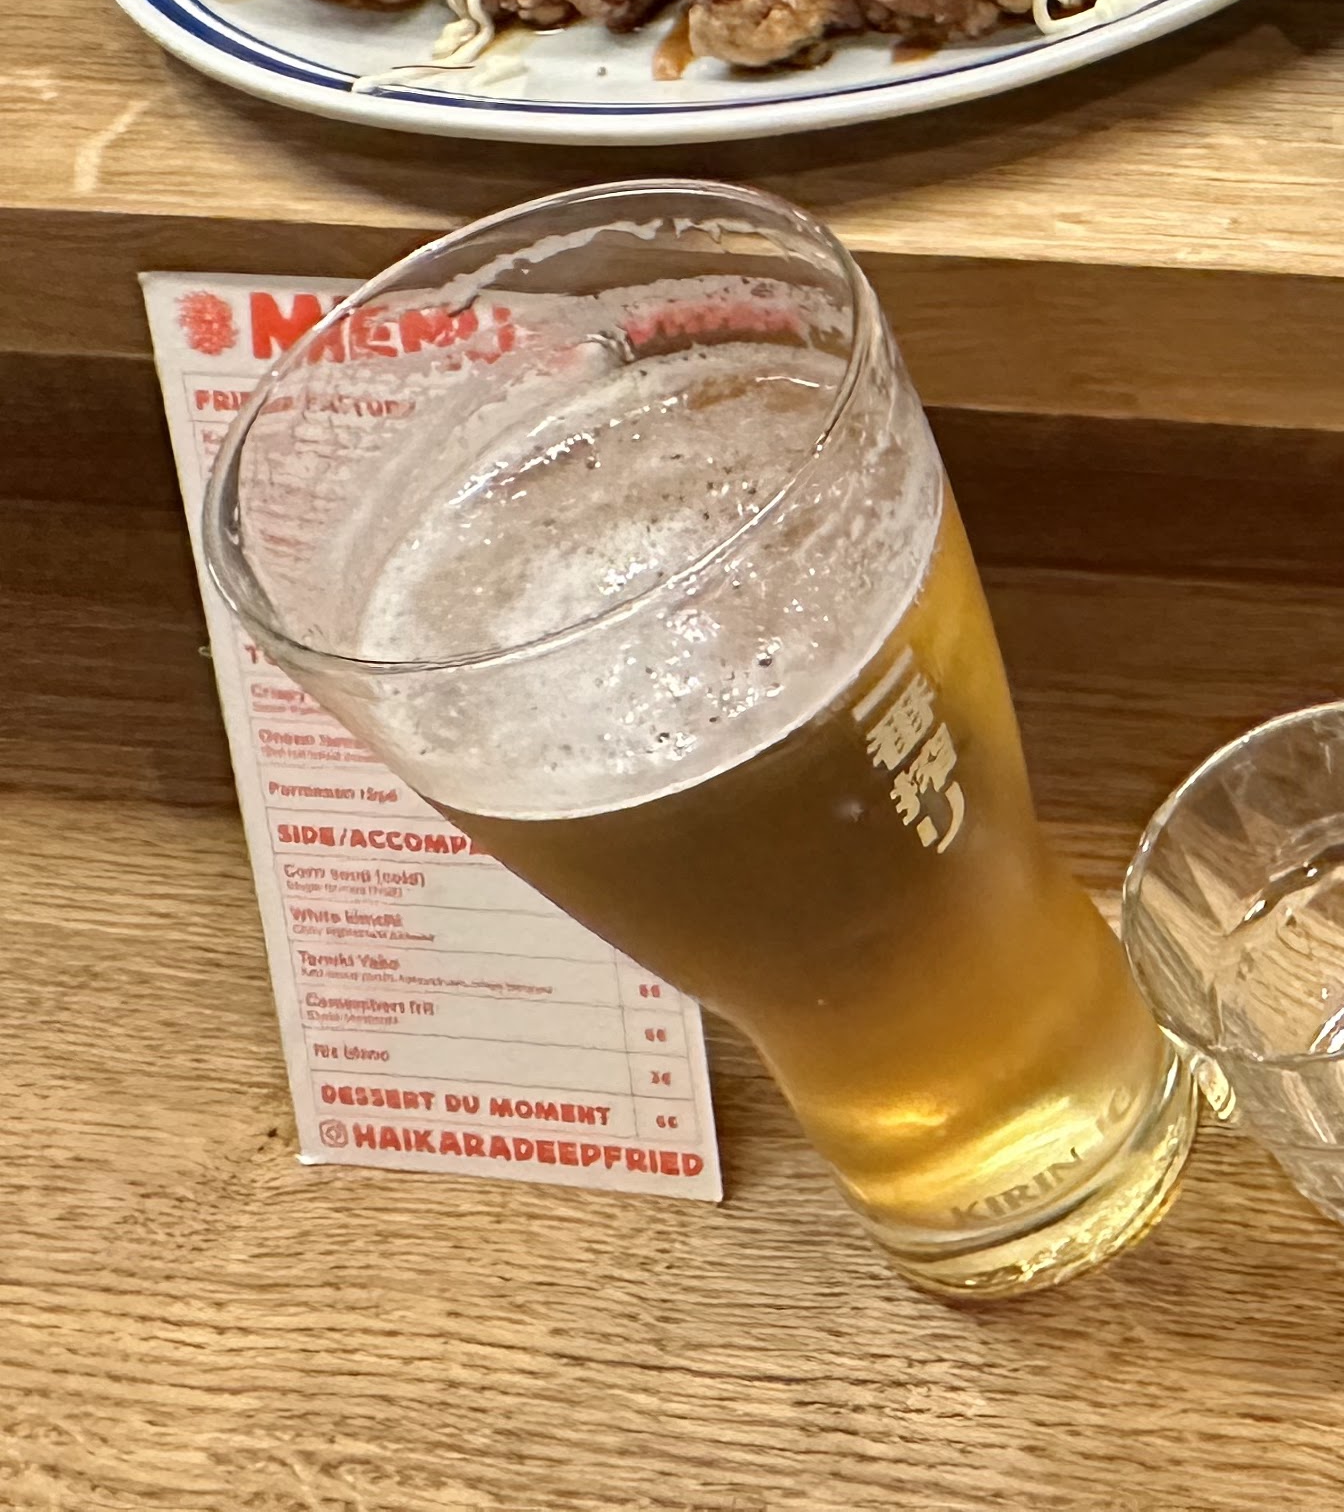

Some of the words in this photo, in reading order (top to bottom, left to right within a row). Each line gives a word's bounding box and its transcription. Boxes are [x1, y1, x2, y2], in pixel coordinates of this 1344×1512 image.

[277, 824, 488, 855] SIDE/ACCOMP
[320, 1083, 436, 1114] DESSERT
[444, 1093, 480, 1116] DU
[489, 1096, 612, 1127] MOMENT
[352, 1122, 706, 1178] HAIKARADEEPFRIED
[951, 1146, 1085, 1222] KIRIN
